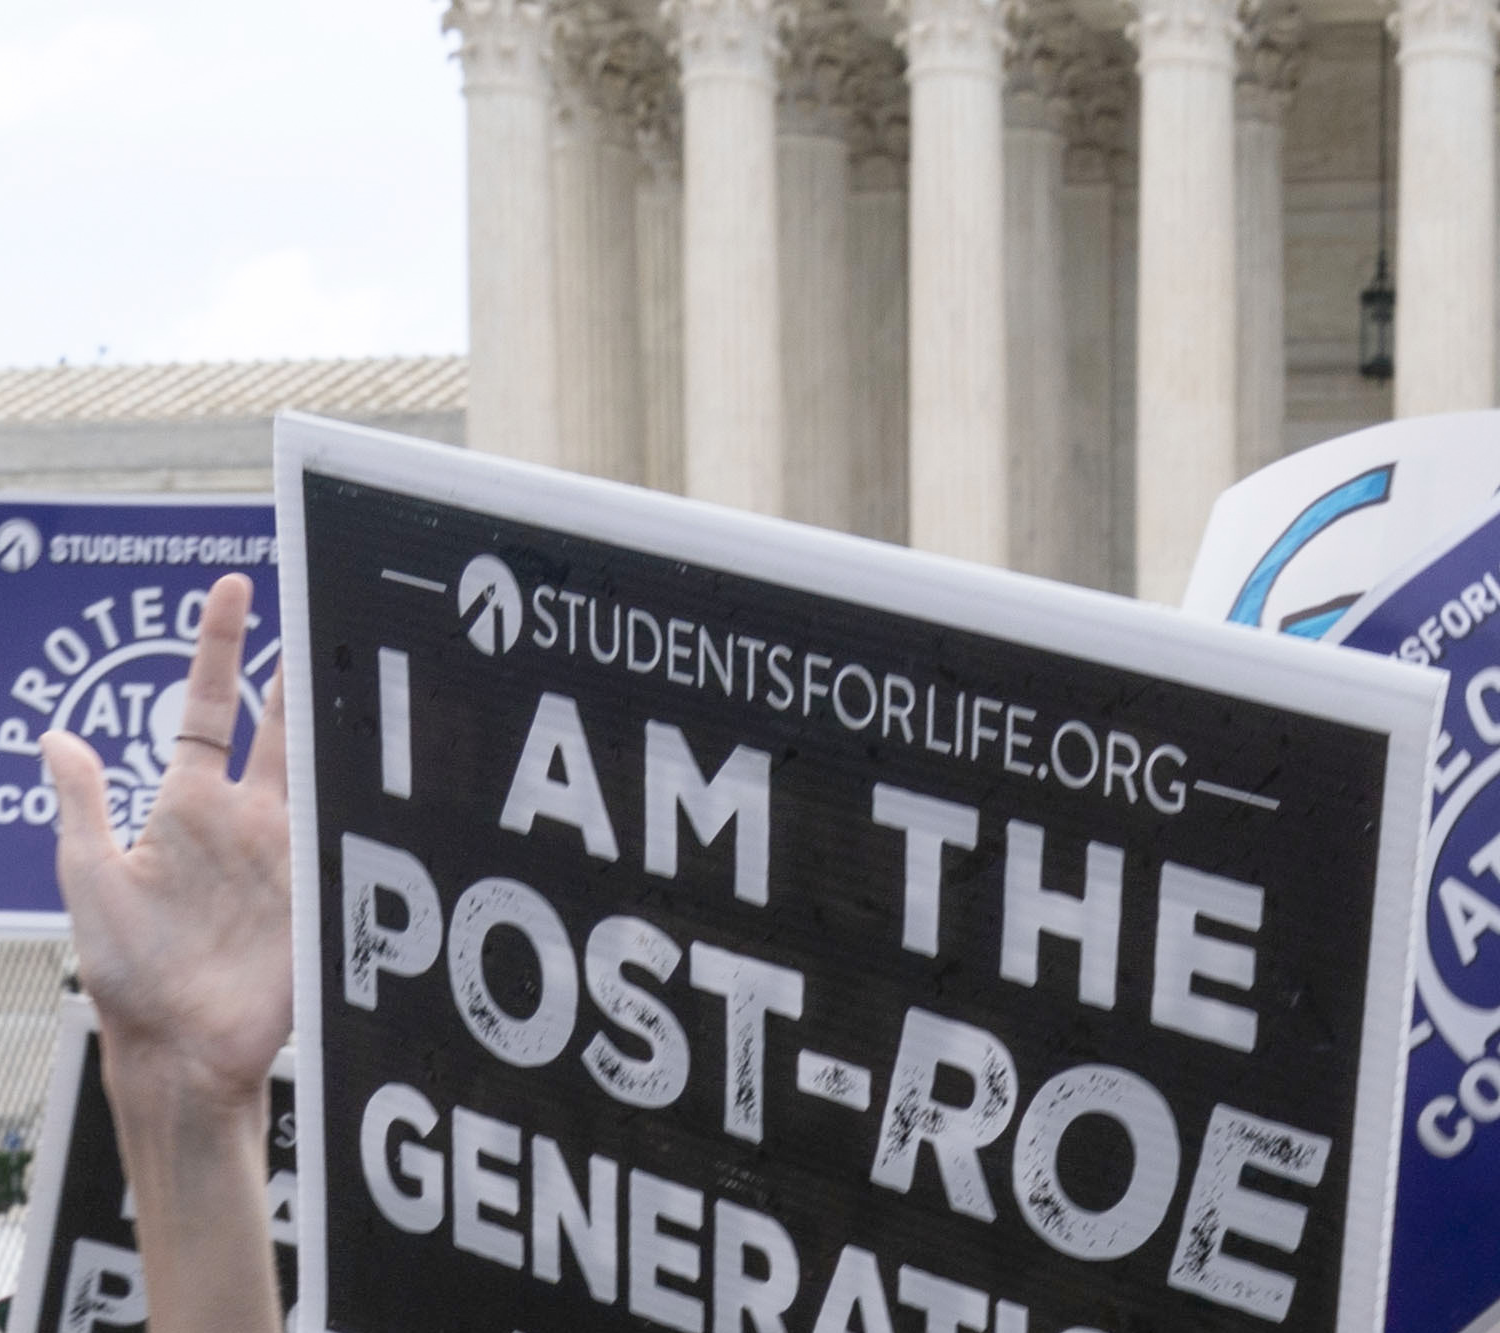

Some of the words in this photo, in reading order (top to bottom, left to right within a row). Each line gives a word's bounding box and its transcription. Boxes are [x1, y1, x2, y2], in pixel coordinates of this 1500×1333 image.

[80, 683, 155, 739] AT
[377, 646, 412, 800] I
[498, 691, 772, 908] AM
[872, 781, 1265, 1054] THE
[532, 583, 1188, 816] STUDENTSFORLIFE.ORG
[340, 830, 1333, 1324] POST-ROE
